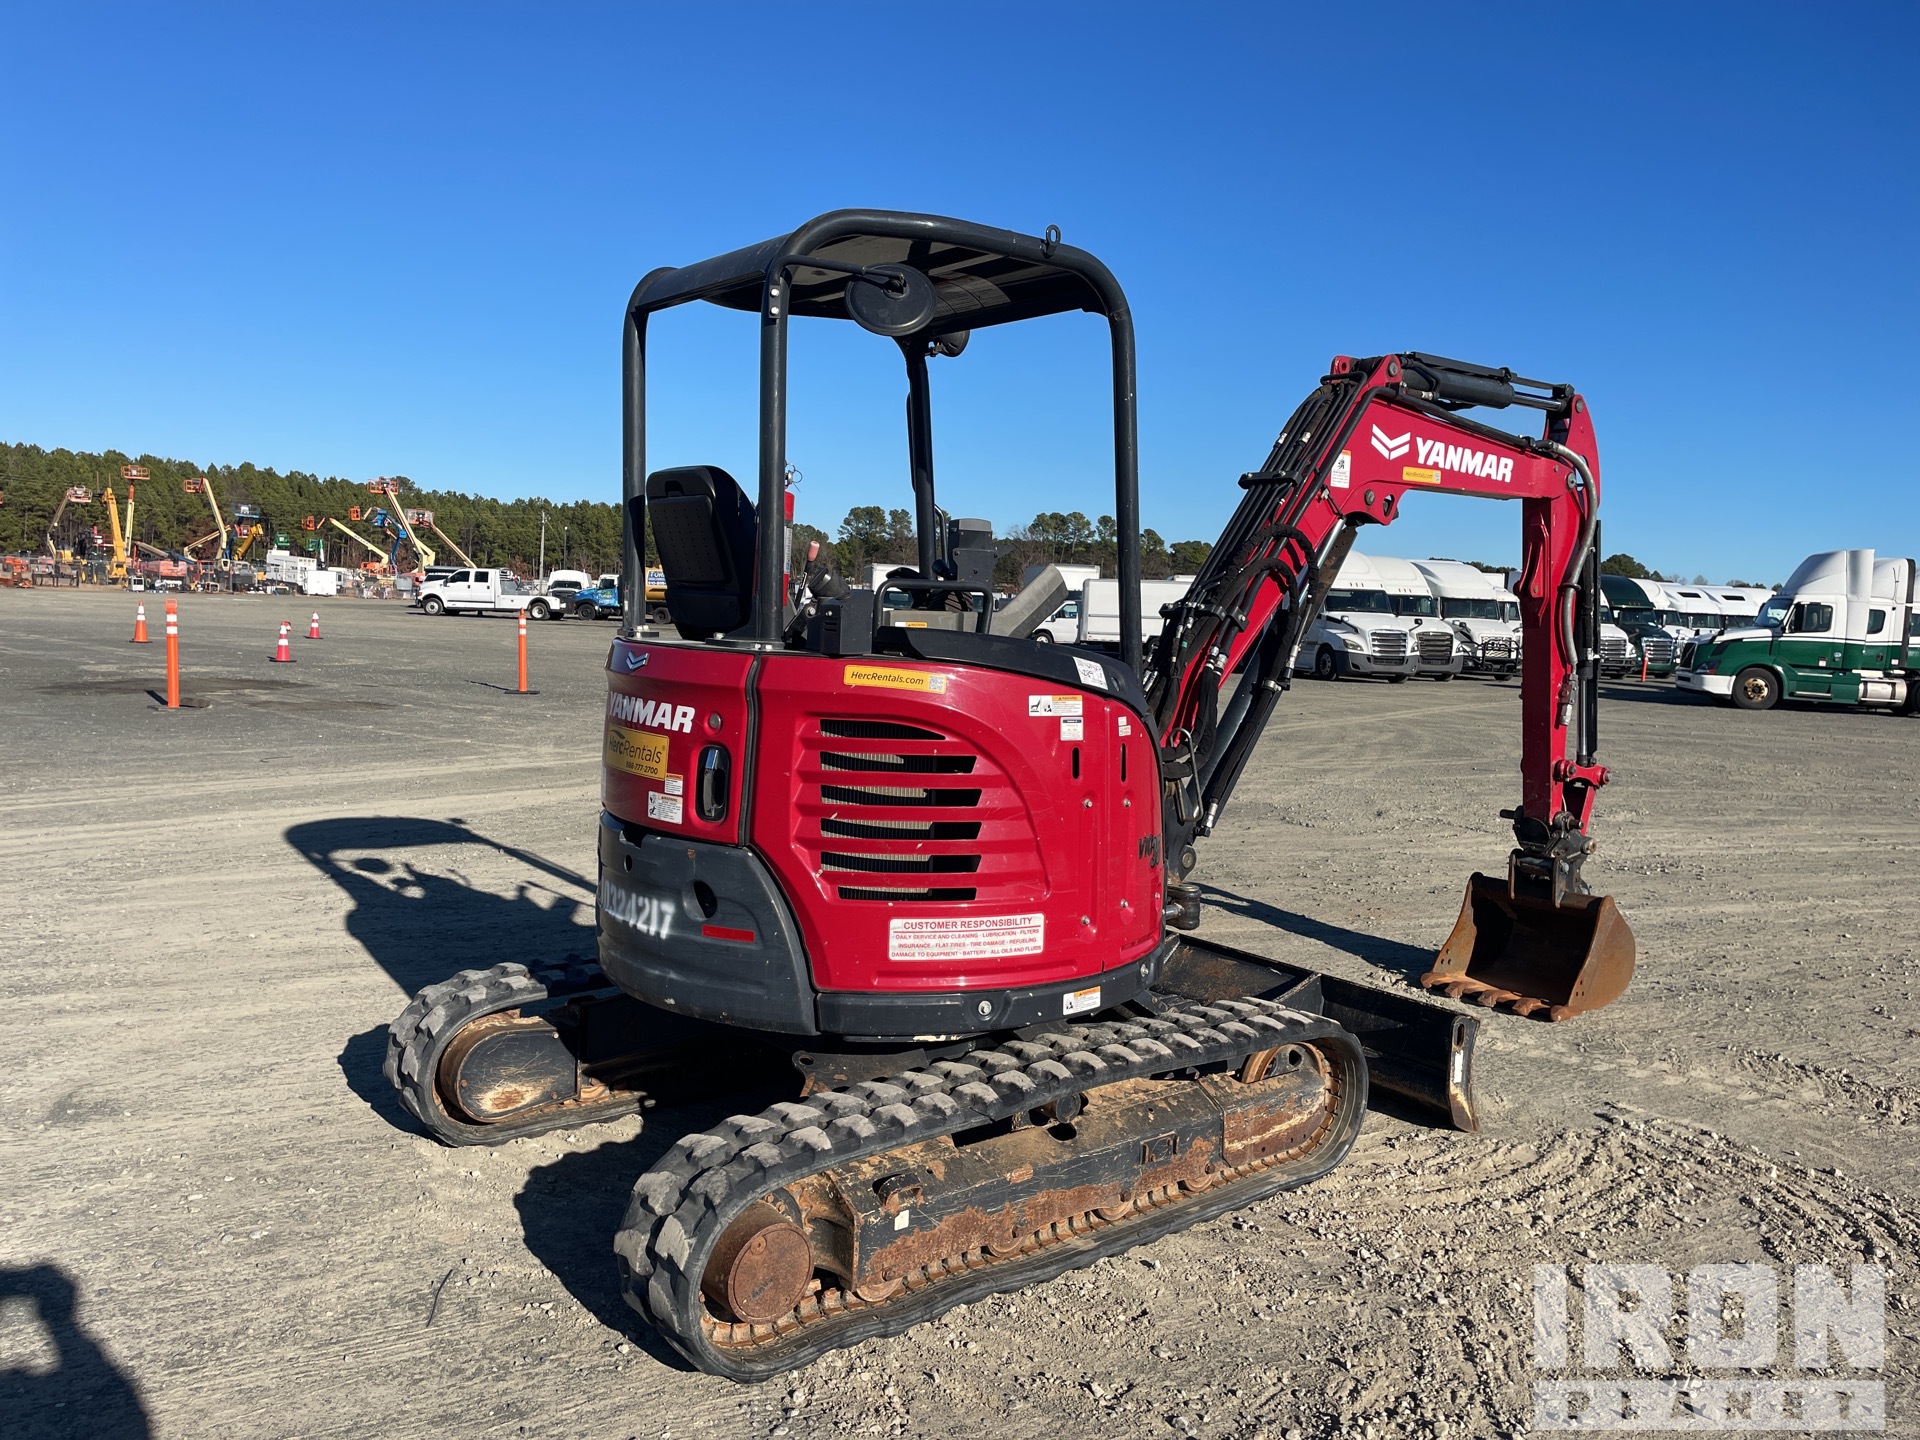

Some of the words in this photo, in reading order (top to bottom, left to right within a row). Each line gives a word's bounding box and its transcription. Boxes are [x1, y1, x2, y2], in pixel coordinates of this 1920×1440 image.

[1416, 437, 1514, 483] YANMAR
[850, 671, 924, 685] HercRentals.com
[609, 691, 696, 734] YANMAR
[608, 735, 662, 764] HercRentals
[903, 921, 958, 930] CUSTOMER
[960, 917, 1033, 929] RESPONSIBILITY
[982, 930, 1017, 938] LUBRICATION
